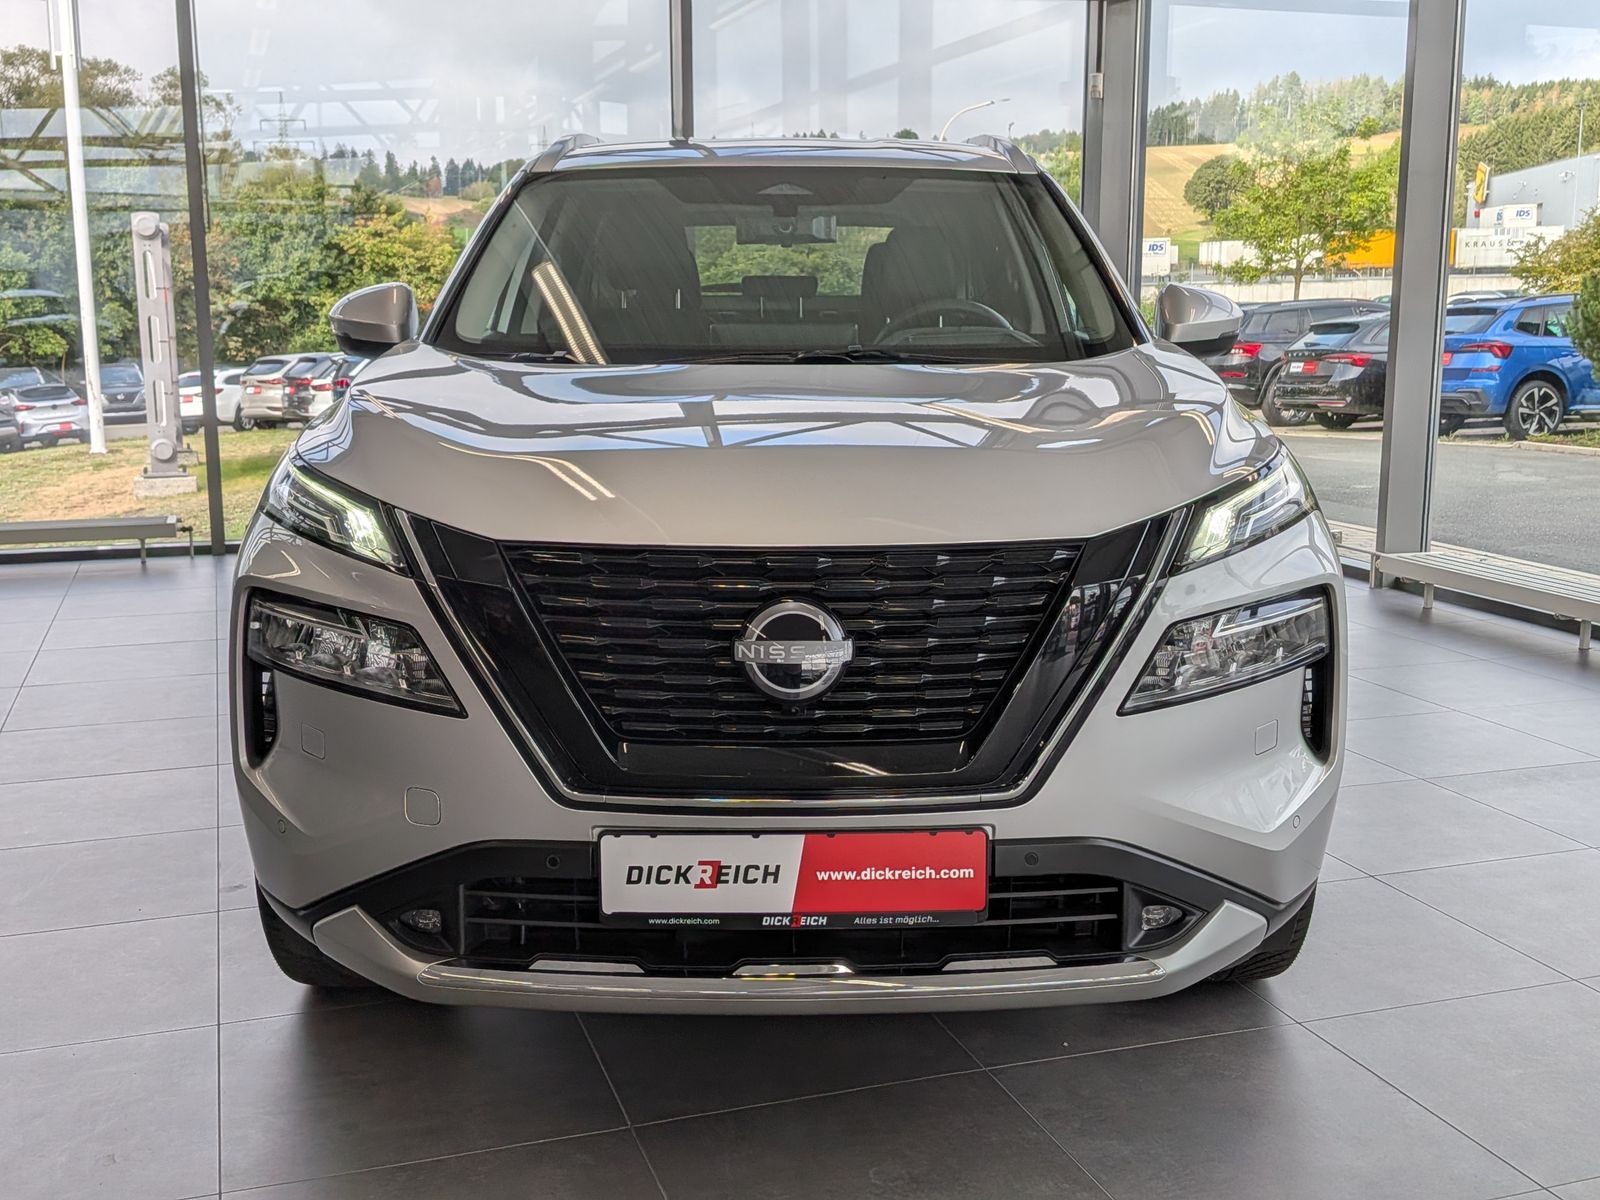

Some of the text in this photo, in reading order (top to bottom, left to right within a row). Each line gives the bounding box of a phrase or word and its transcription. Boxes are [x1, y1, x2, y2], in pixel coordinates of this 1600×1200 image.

[1148, 243, 1164, 251] IDS
[738, 644, 849, 660] NISS
[626, 864, 975, 885] DICKREICH www.dickreich.com
[648, 917, 721, 926] www.dickreich.com
[854, 915, 940, 926] Alles ist möglich...
